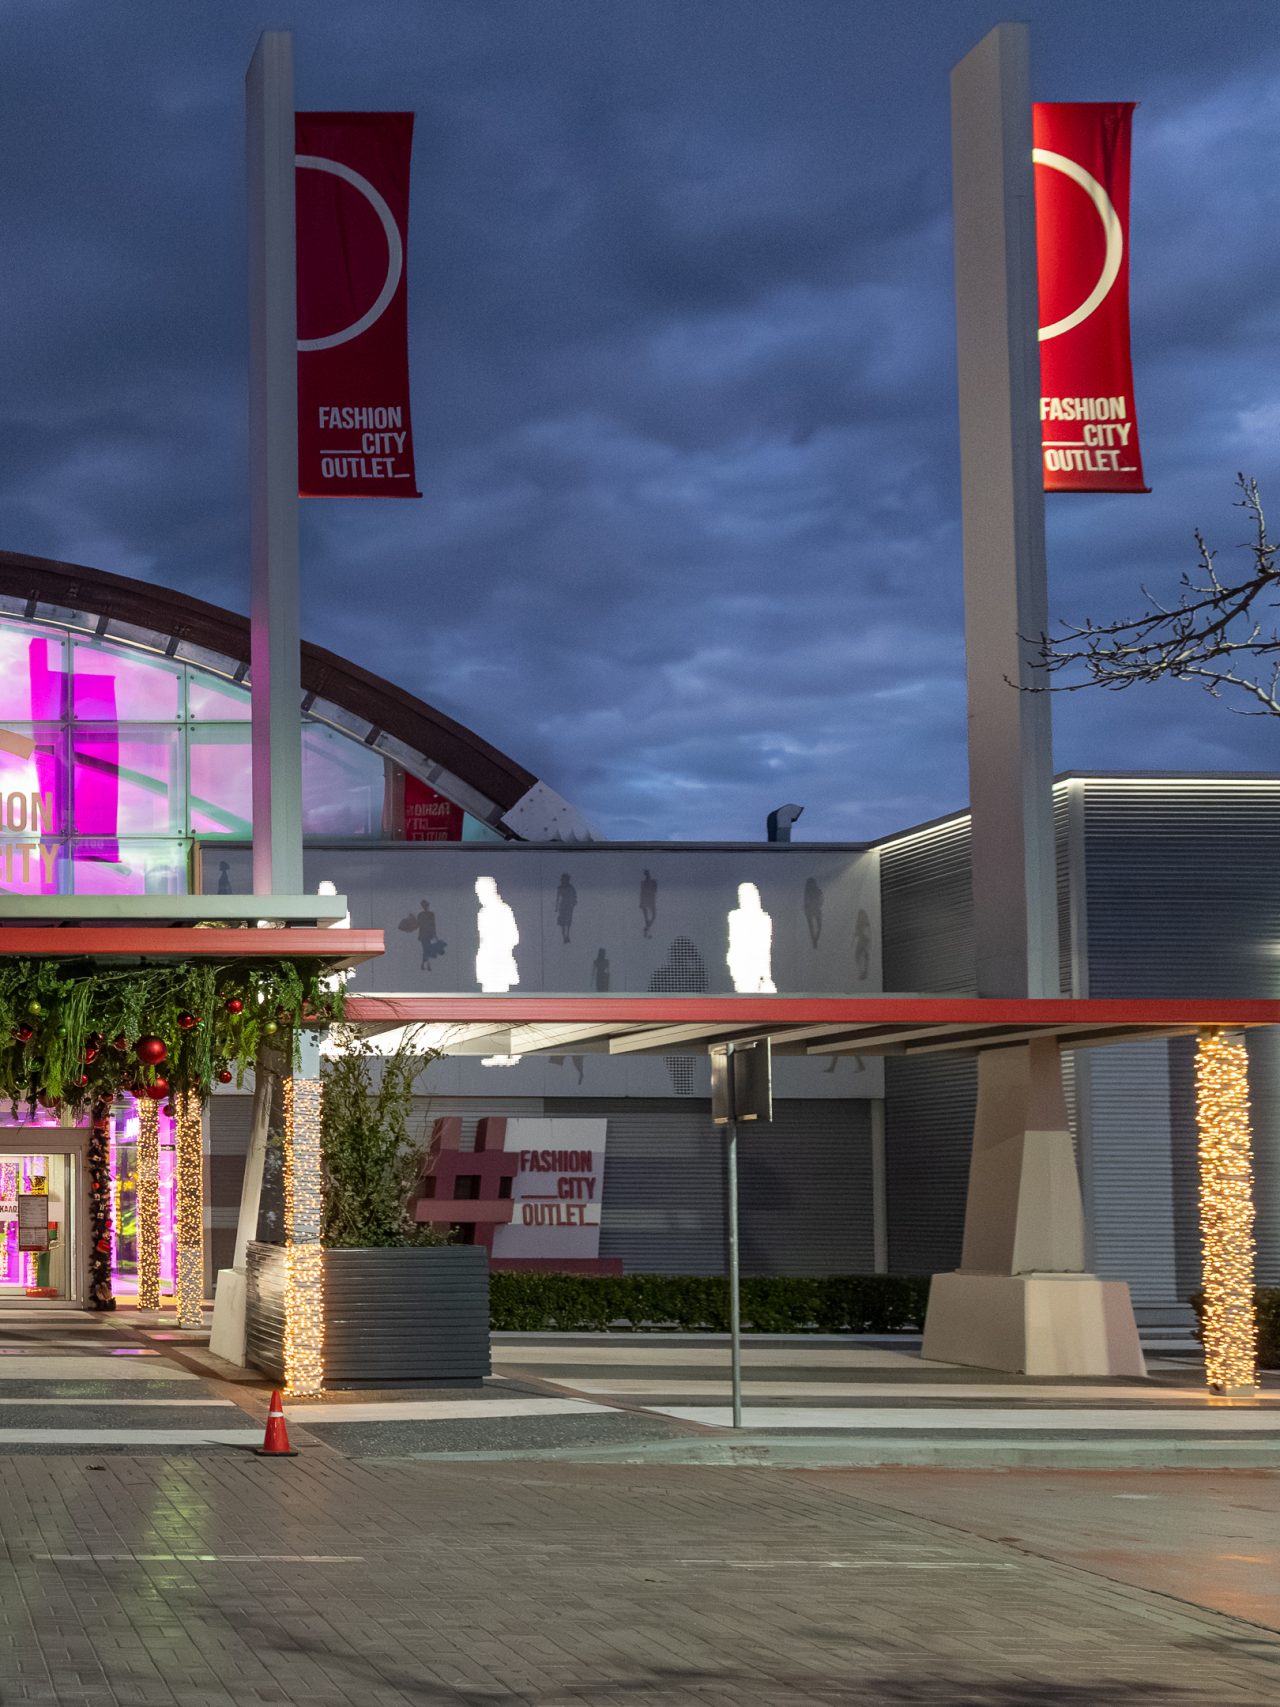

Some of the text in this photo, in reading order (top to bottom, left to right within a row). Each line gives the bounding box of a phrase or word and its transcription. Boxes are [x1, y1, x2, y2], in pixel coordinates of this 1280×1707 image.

[319, 406, 402, 429] FASHION
[1040, 395, 1126, 421] FASHION
[361, 431, 407, 455] CITY
[1083, 422, 1132, 447] CITY
[321, 457, 396, 478] OUTLET
[1044, 449, 1120, 471] OUTLET
[520, 1150, 593, 1173] FASHION
[558, 1177, 597, 1200] CITY
[0, 1205, 18, 1213] ΚΑΛΩ
[522, 1203, 587, 1226] OUTLET
